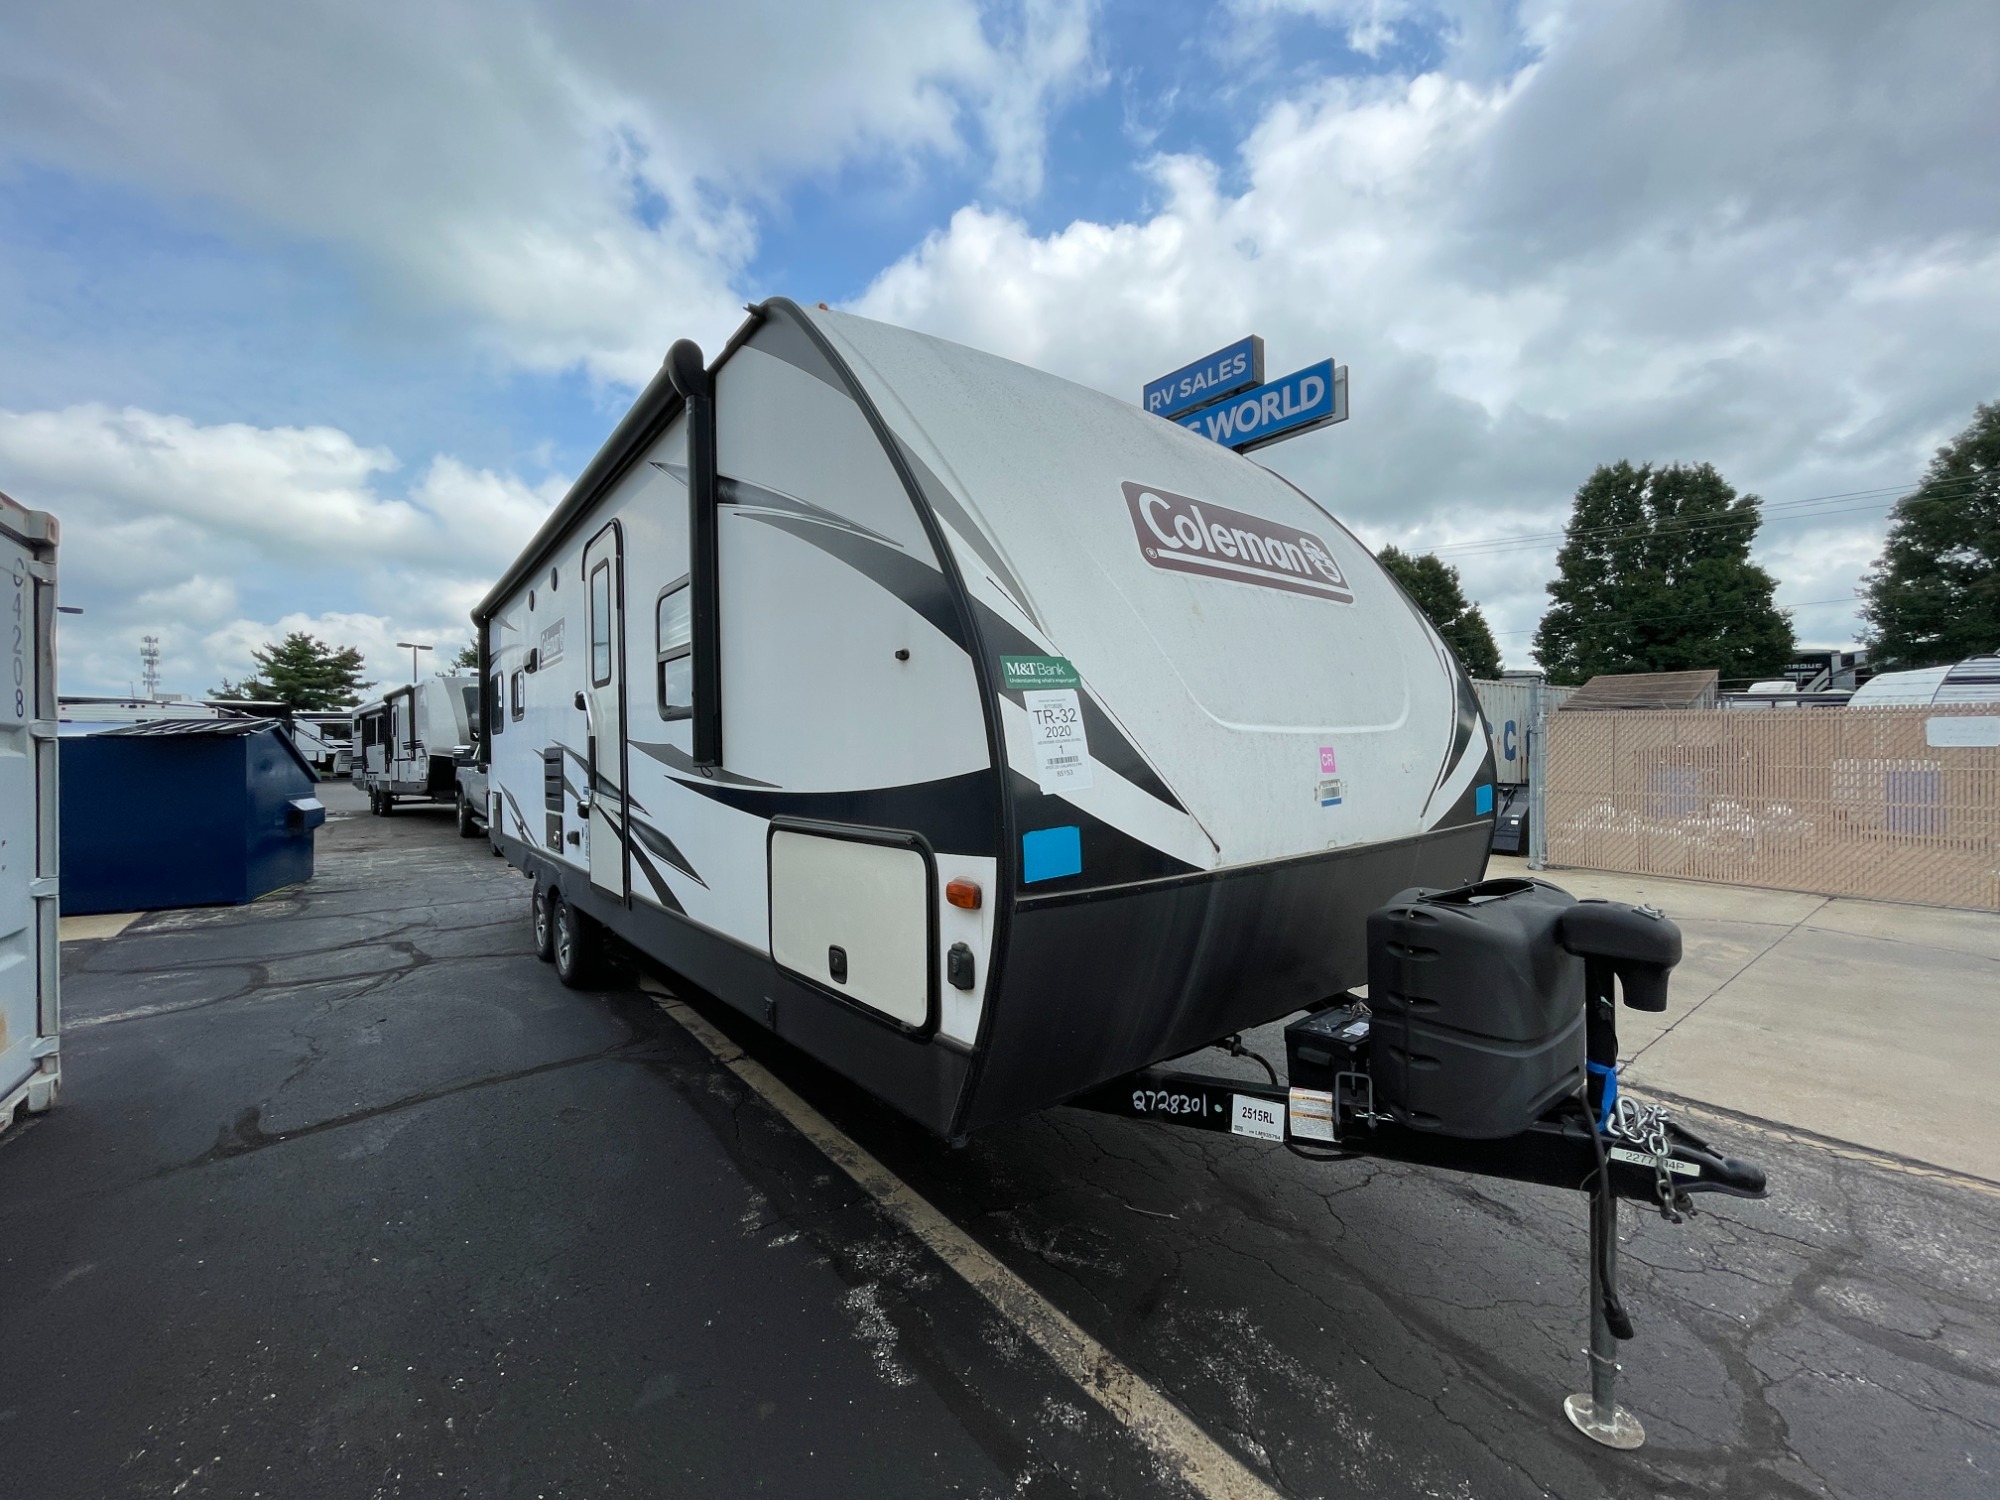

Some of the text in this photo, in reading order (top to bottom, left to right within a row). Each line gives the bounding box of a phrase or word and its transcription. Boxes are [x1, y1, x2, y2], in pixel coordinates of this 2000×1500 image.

[1149, 353, 1247, 412] RV SALES
[1206, 375, 1325, 443] WORLD
[1138, 492, 1313, 576] Coleman
[1006, 662, 1066, 676] M&T Bank
[1033, 708, 1077, 725] TR-32
[1045, 725, 1072, 738] 2020
[1059, 745, 1064, 755] 1
[1132, 1090, 1207, 1116] 2728301
[1242, 1106, 1275, 1125] 2515RL
[1625, 1151, 1685, 1171] 22774P
